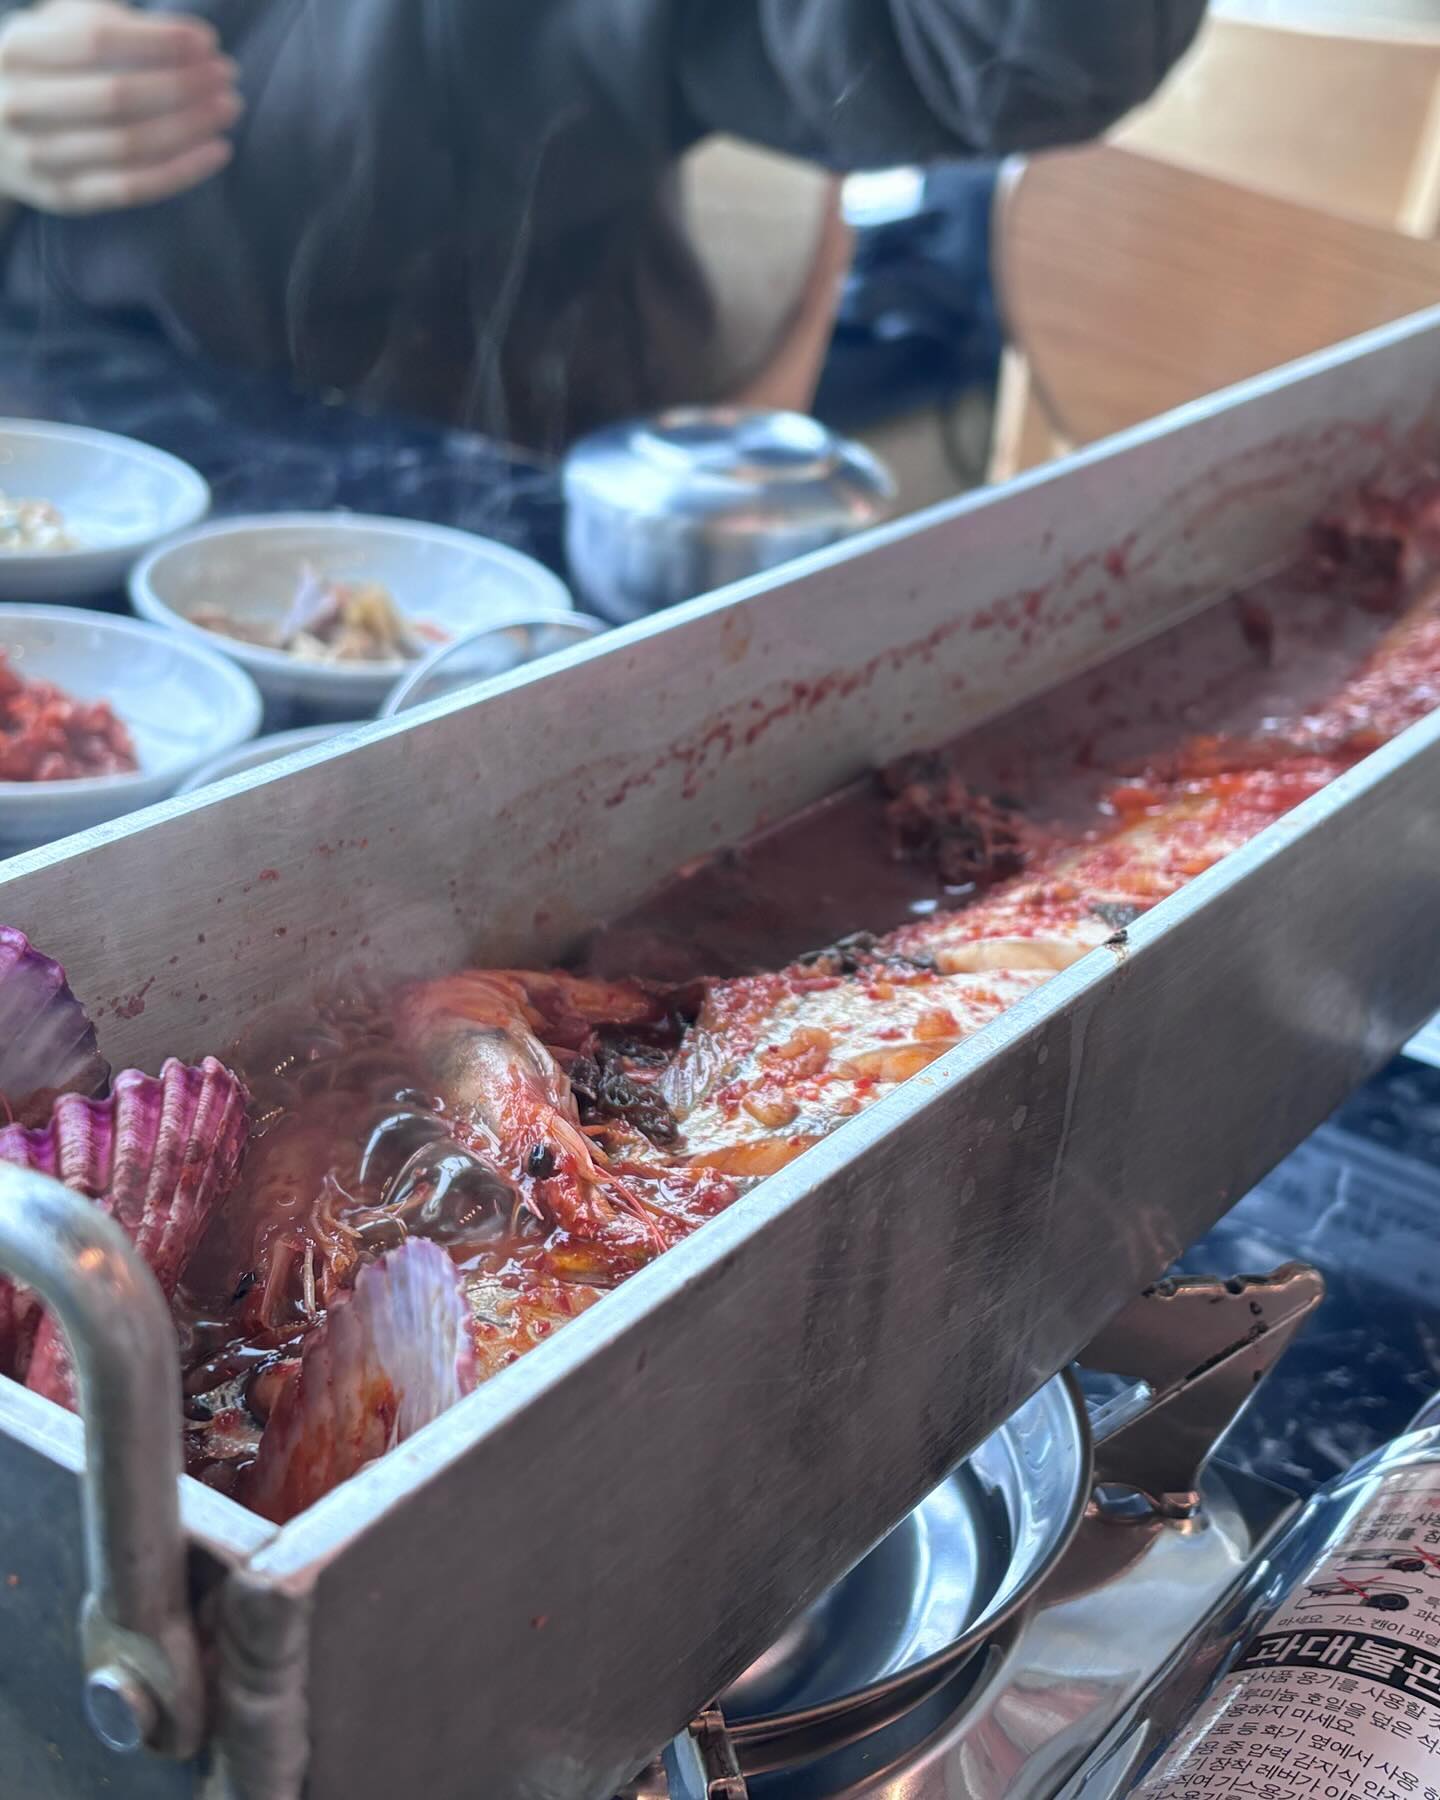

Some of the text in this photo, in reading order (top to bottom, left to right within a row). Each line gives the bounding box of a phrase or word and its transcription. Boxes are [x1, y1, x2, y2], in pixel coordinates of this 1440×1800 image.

[1331, 1614, 1367, 1628] 가스
[1297, 1671, 1359, 1693] 용기를
[1361, 1687, 1427, 1720] 사용할
[1291, 1709, 1356, 1737] 마세요.
[1301, 1692, 1366, 1719] 호일을
[1370, 1710, 1413, 1740] 덮은
[1417, 1734, 1440, 1755] 석
[1209, 1757, 1253, 1774] 장착
[1255, 1764, 1321, 1793] 레버가
[1222, 1740, 1245, 1755] 중
[1247, 1743, 1293, 1763] 압력
[1292, 1752, 1360, 1788] 감지식
[1237, 1722, 1260, 1736] 등
[1260, 1725, 1306, 1744] 화기
[1308, 1734, 1374, 1768] 옆에서
[1374, 1762, 1419, 1792] 사용
